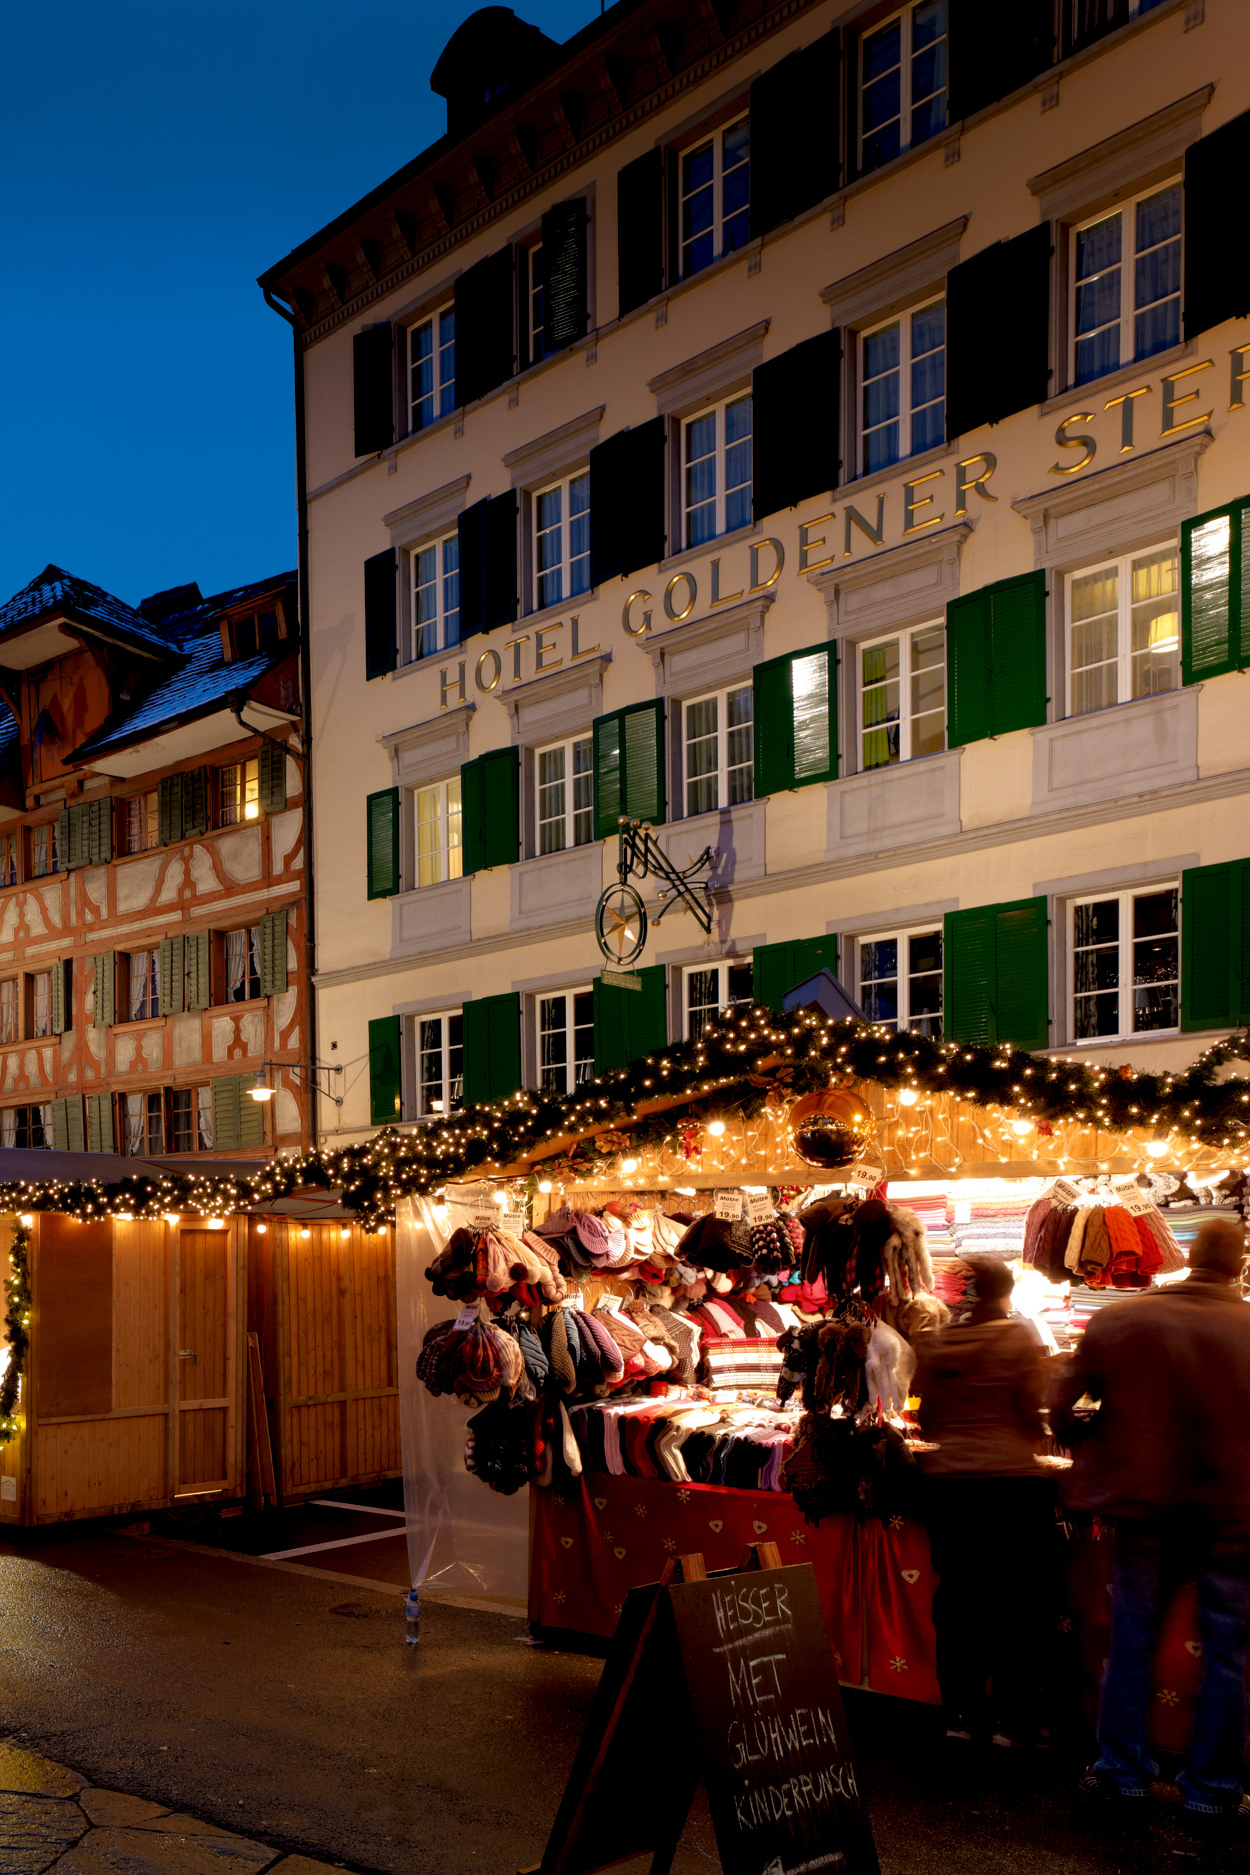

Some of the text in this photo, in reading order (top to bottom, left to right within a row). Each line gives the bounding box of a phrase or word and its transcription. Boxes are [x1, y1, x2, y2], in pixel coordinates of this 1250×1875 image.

[438, 614, 601, 710] HOTEL
[621, 451, 998, 638] GOLDENER
[856, 1169, 877, 1182] 19.90
[1057, 1182, 1077, 1200] Mütze
[1115, 1183, 1135, 1193] Mütze
[720, 1195, 740, 1203] Mütze
[749, 1195, 769, 1204] Mütze
[719, 1211, 740, 1219] 19.90
[1130, 1203, 1152, 1214] 19.90
[753, 1214, 773, 1223] 19.90
[712, 1580, 792, 1637] HEISSER
[727, 1653, 787, 1706] MET
[727, 1709, 836, 1770] GLÜHWEIN
[733, 1762, 859, 1831] KINDERPUNSCH
